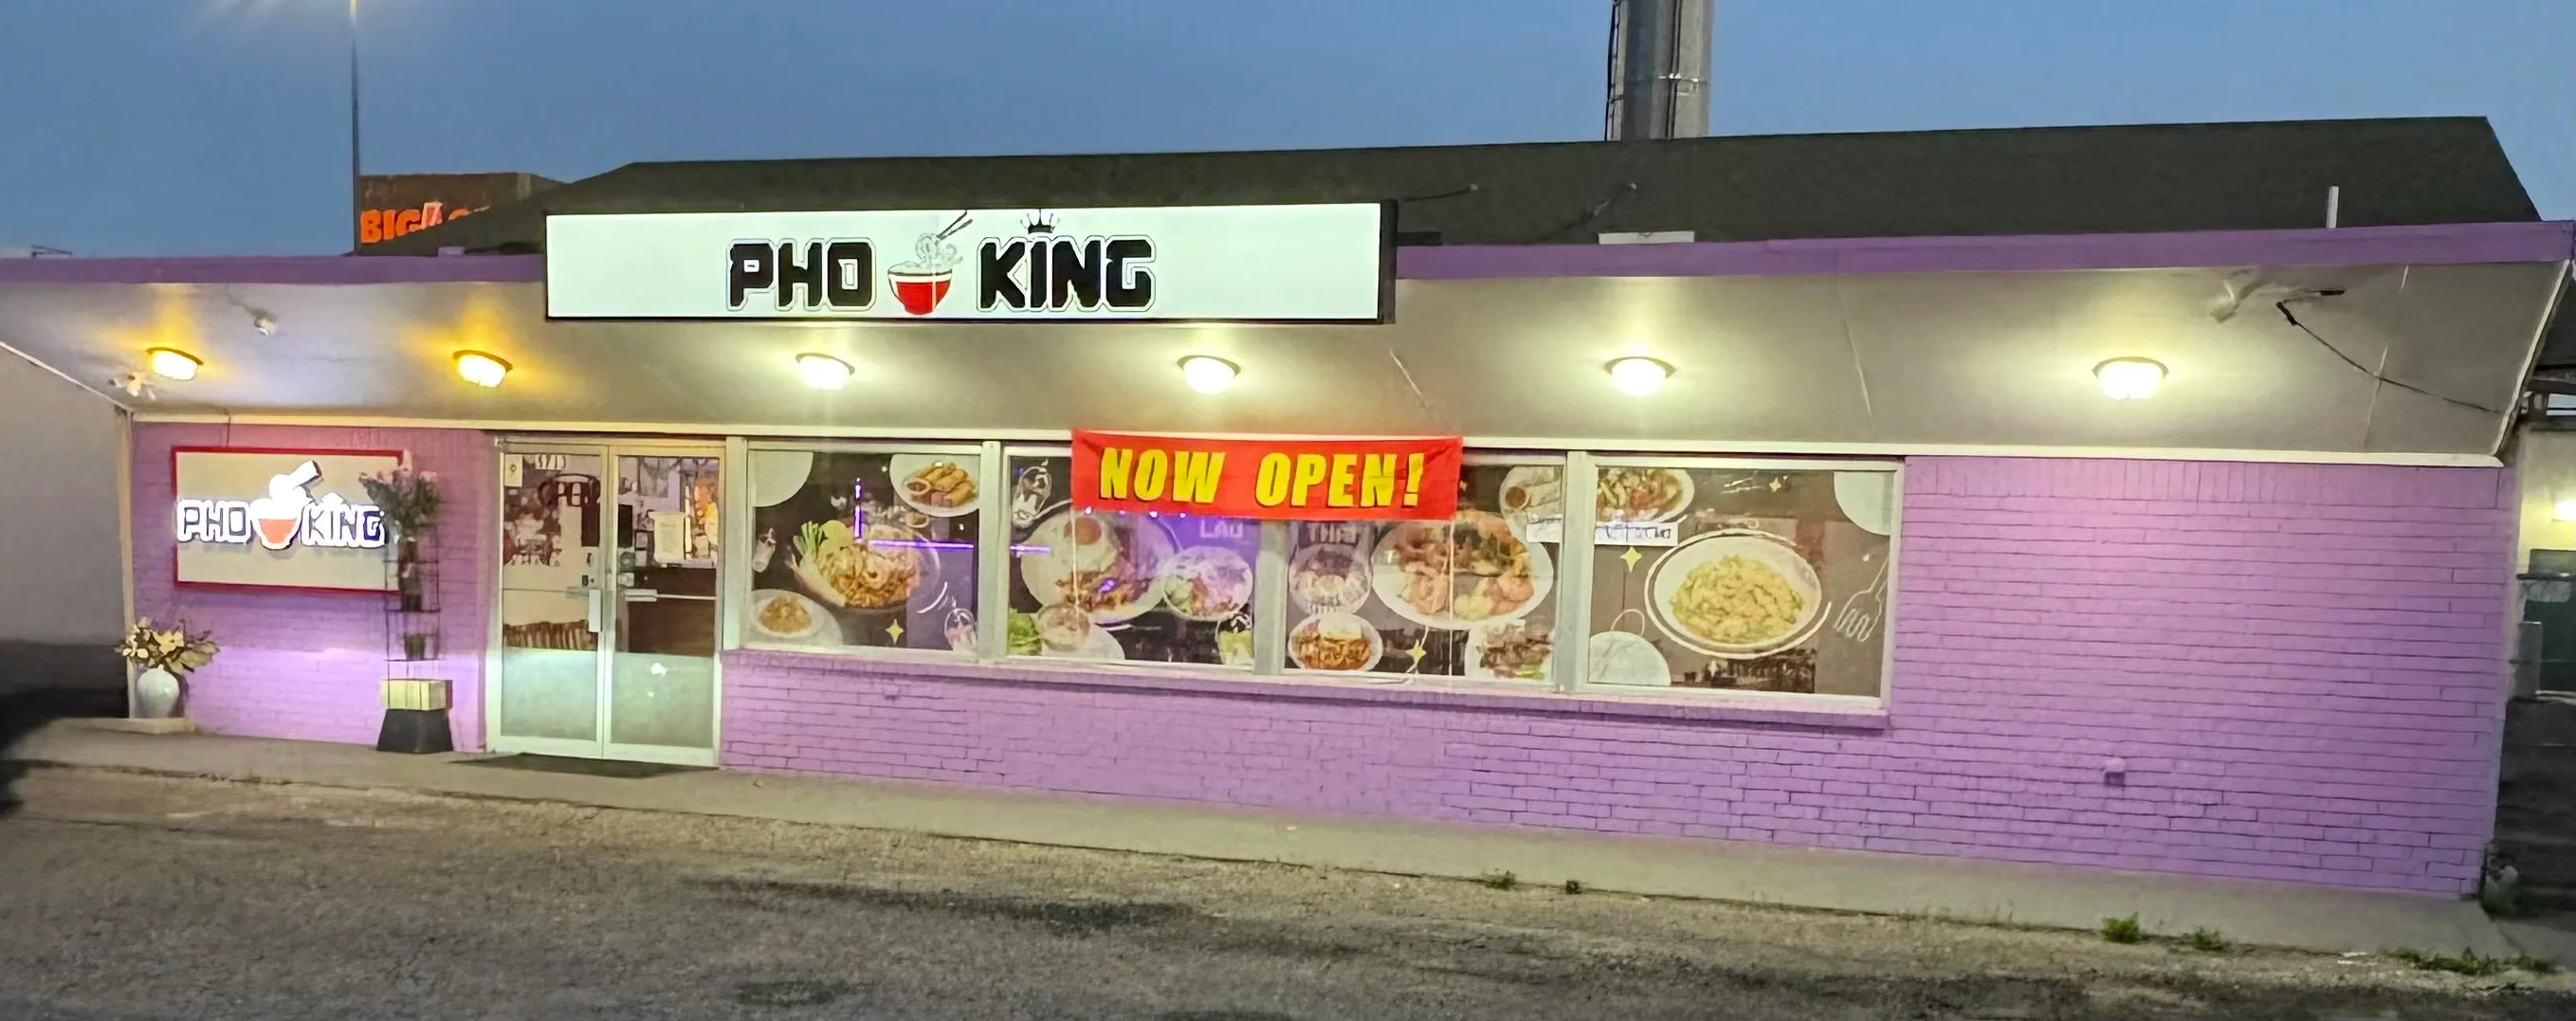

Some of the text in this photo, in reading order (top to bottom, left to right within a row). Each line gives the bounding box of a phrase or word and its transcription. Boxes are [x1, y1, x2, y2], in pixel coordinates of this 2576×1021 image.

[728, 237, 1156, 310] PHO KING
[1099, 447, 1425, 507] NOW OPEN!
[178, 501, 384, 546] PHO KING
